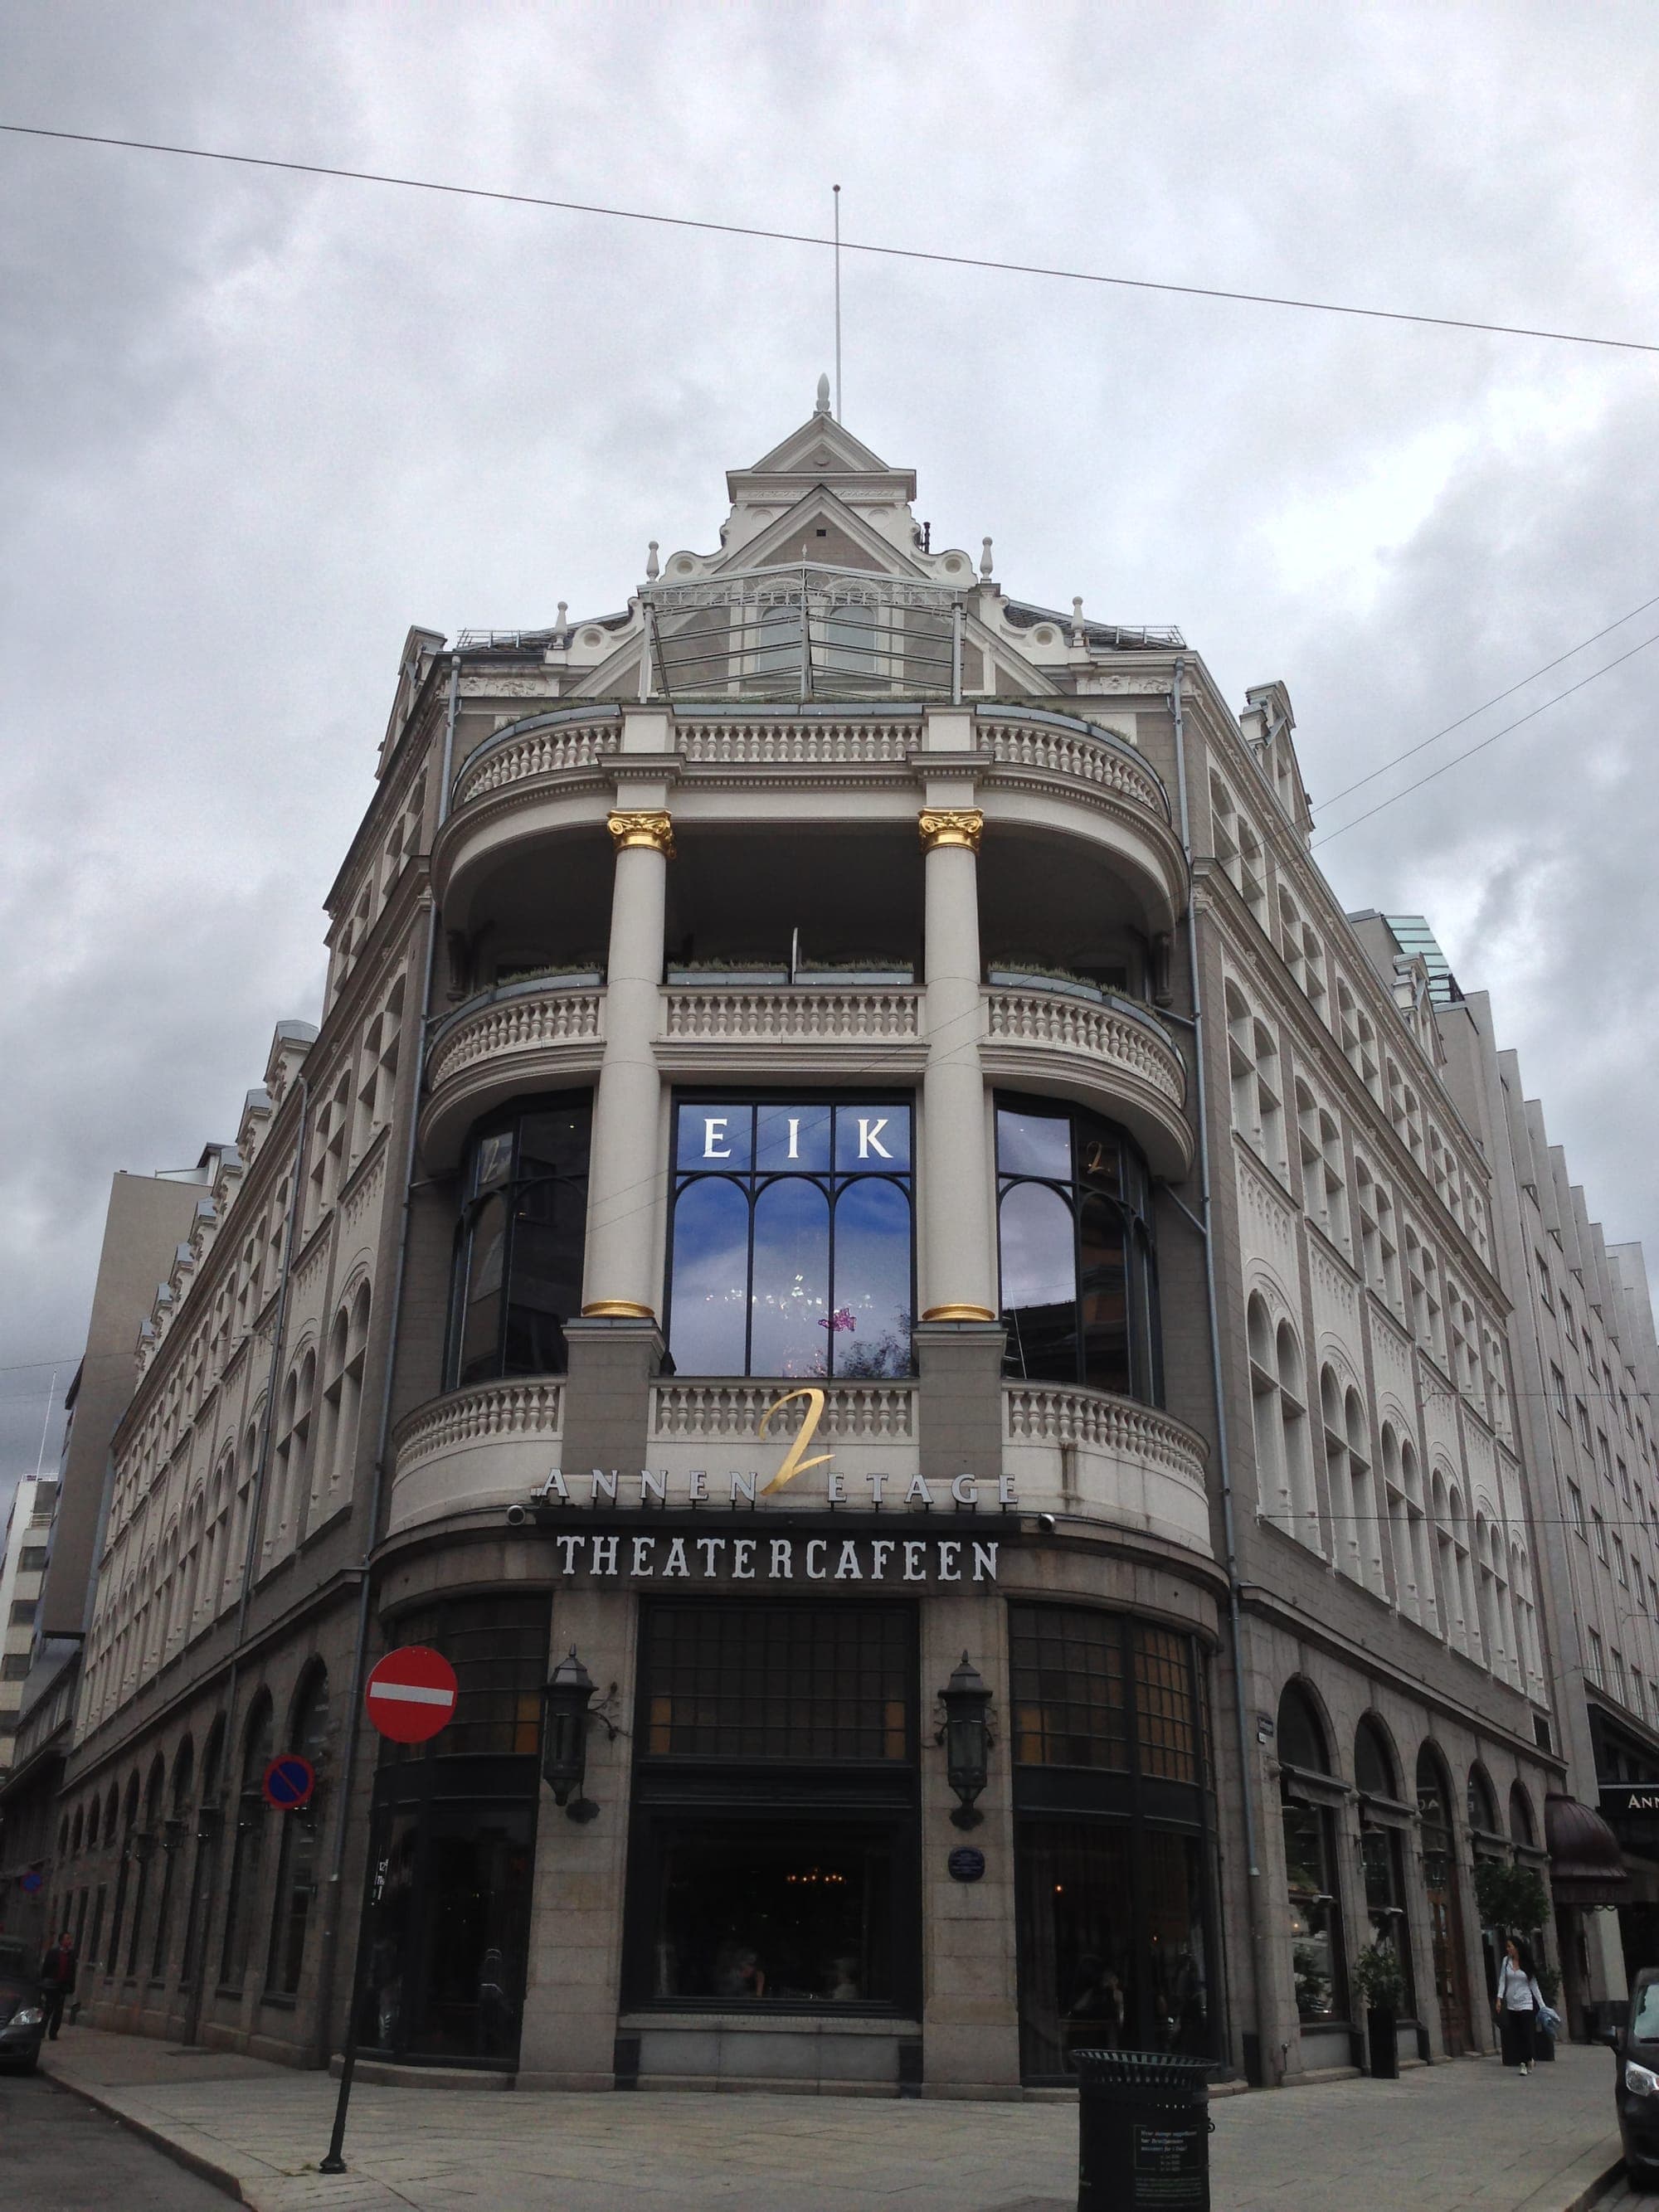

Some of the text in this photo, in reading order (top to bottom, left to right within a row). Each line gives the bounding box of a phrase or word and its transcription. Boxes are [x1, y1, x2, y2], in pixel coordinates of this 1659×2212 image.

[703, 1118, 893, 1159] EIK
[758, 1388, 835, 1496] 2
[542, 1467, 1019, 1505] ANNEN ETAGE
[557, 1536, 999, 1581] THEATERCAFEEN
